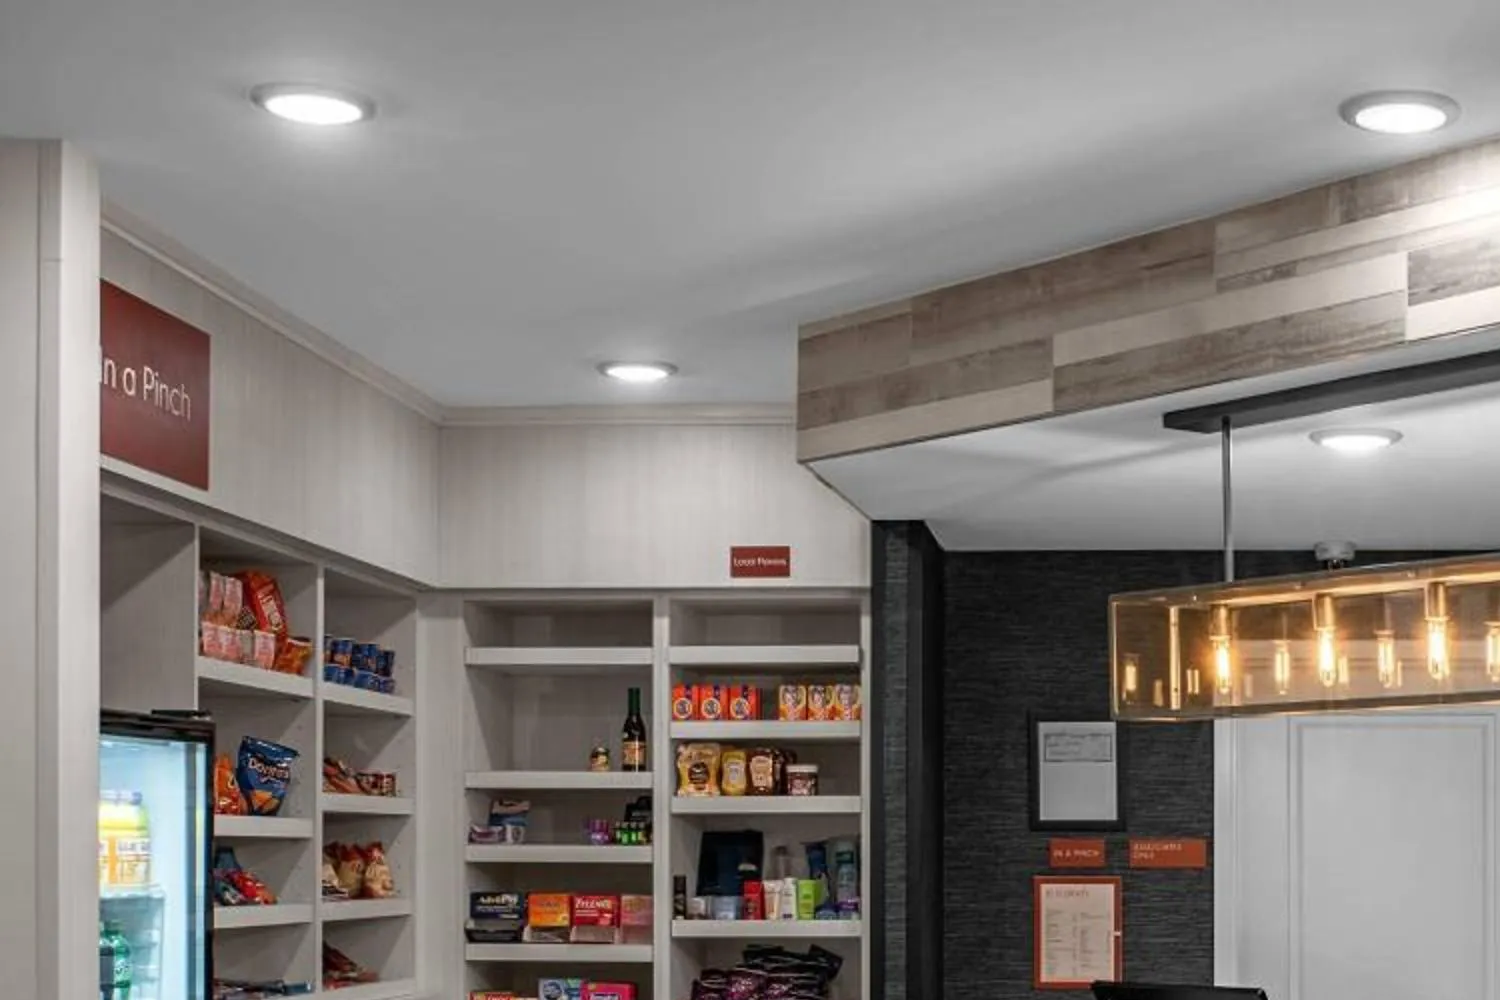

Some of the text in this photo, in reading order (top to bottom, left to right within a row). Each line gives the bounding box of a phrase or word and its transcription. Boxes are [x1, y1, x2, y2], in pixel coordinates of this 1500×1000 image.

[122, 367, 137, 396] a
[143, 366, 191, 421] Pinch
[248, 758, 290, 779] Doritos
